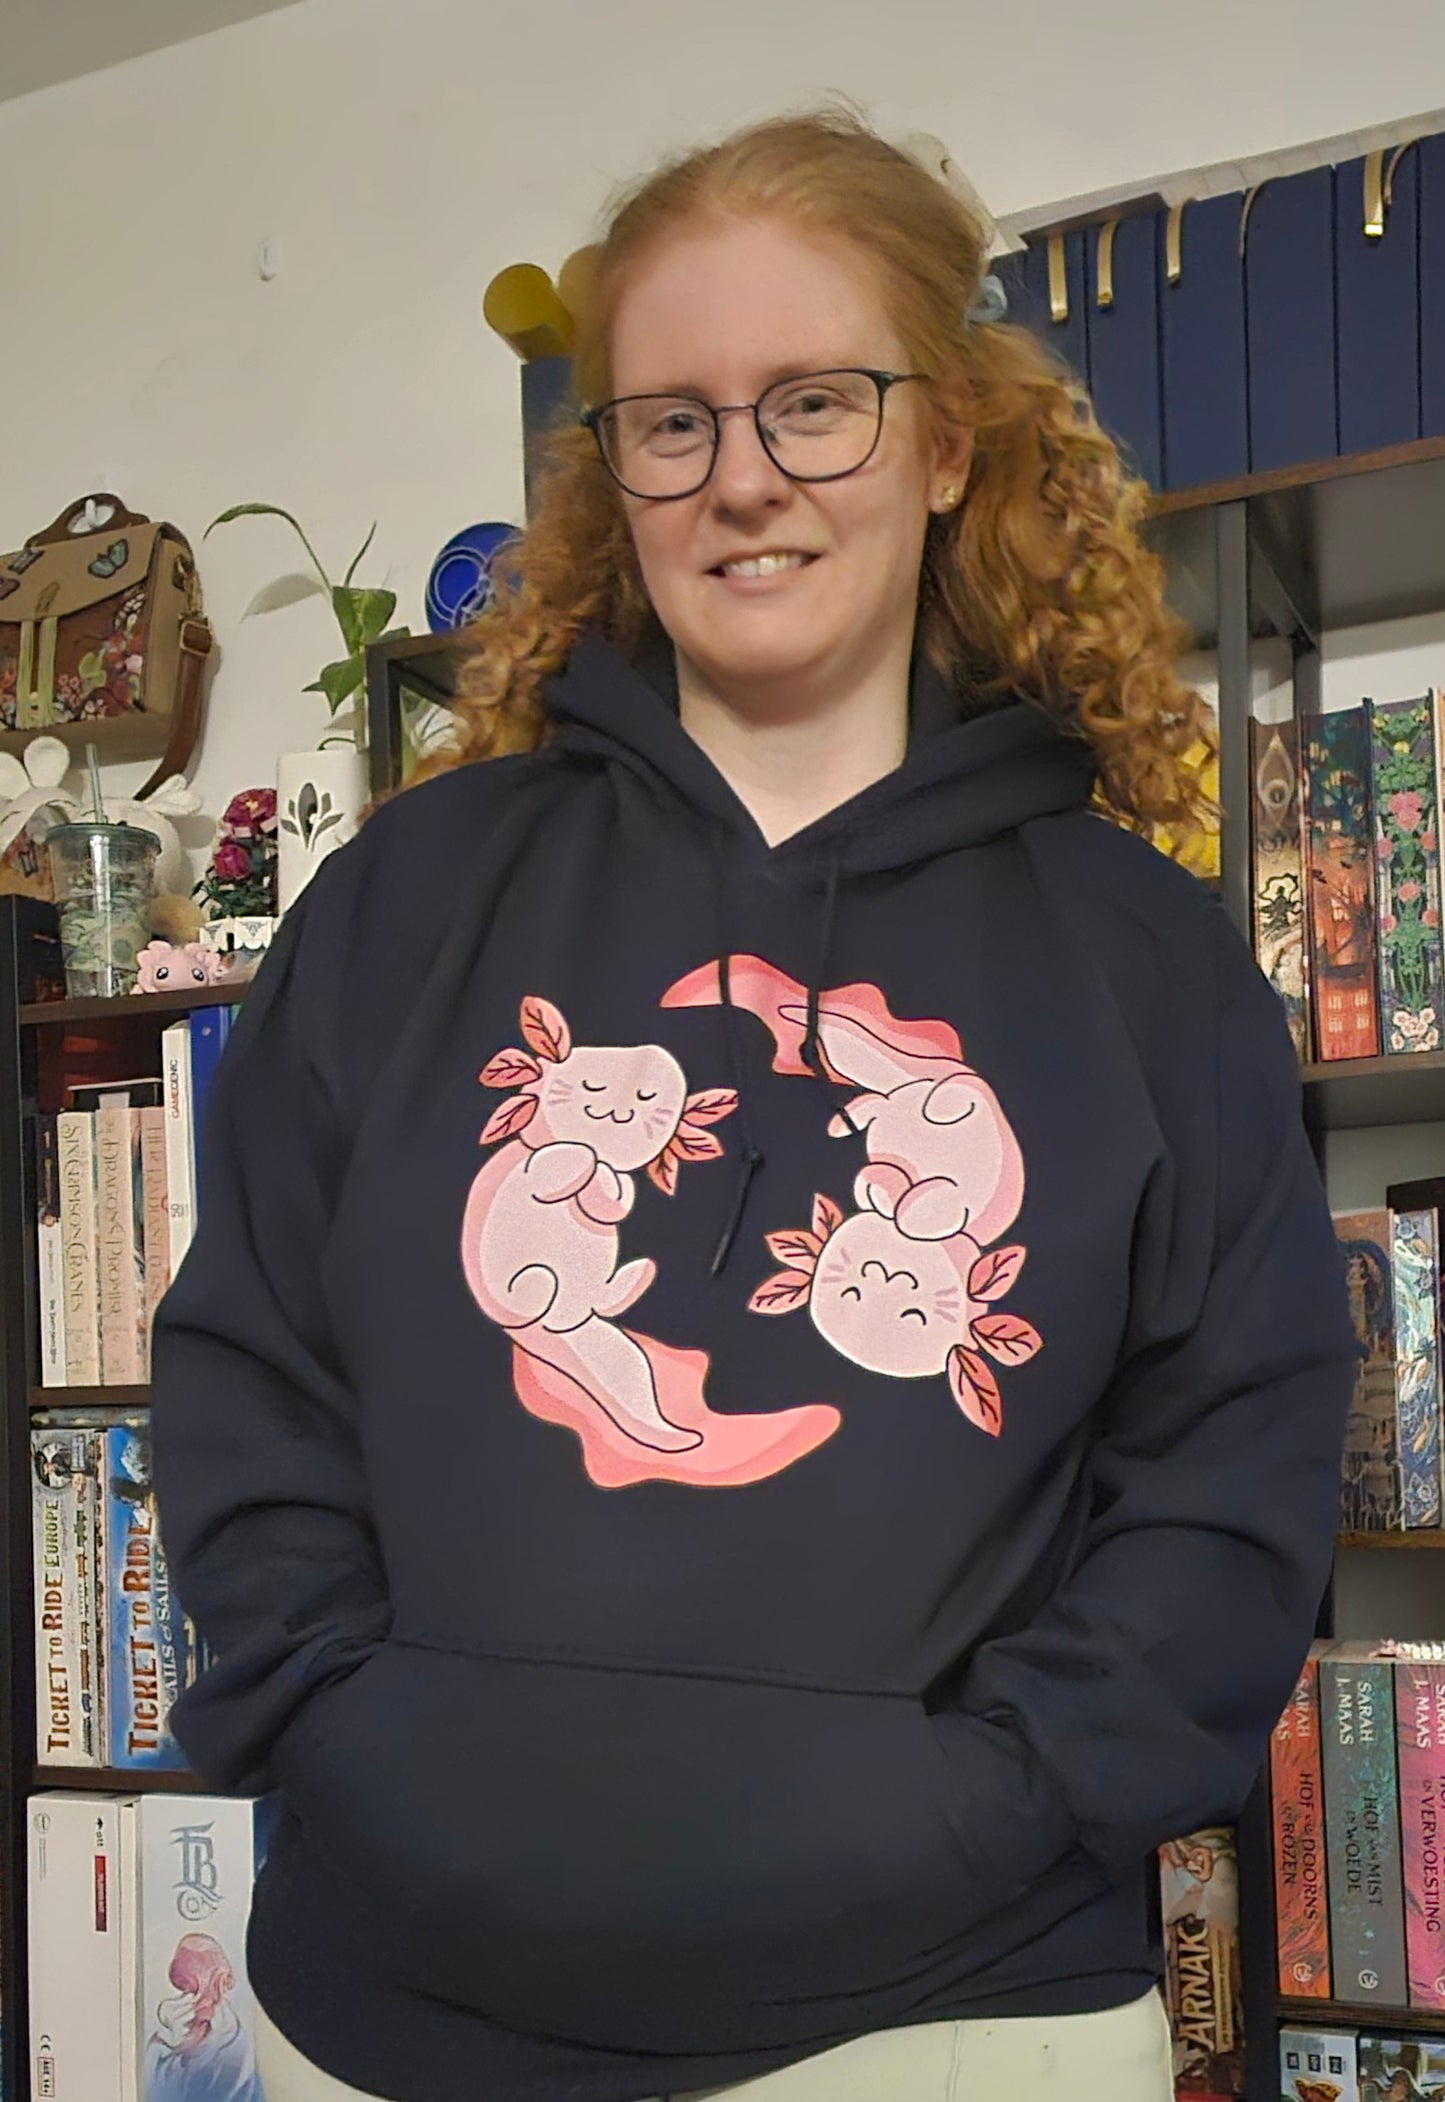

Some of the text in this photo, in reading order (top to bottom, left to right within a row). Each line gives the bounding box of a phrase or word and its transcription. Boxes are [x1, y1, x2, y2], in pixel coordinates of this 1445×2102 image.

[155, 1561, 171, 1621] SAILS
[41, 1499, 71, 1753] TICKET TO RIDE EUROPE
[122, 1517, 159, 1755] TICKET TO RIDE
[1295, 1678, 1310, 1737] SARAH
[1338, 1694, 1355, 1745] MAAS
[1357, 1681, 1375, 1742] SARAH
[1415, 1696, 1431, 1748] MAAS
[1299, 1772, 1314, 1808] HOF
[1363, 1796, 1379, 1834] HOF
[1281, 1821, 1297, 1885] ROZEN
[1301, 1838, 1317, 1920] DOORNS
[1345, 1826, 1362, 1894] WOEDE
[1421, 1795, 1441, 1934] VERWOESTING
[1366, 1863, 1383, 1907] MIST
[1177, 1925, 1216, 2053] ARNAK
